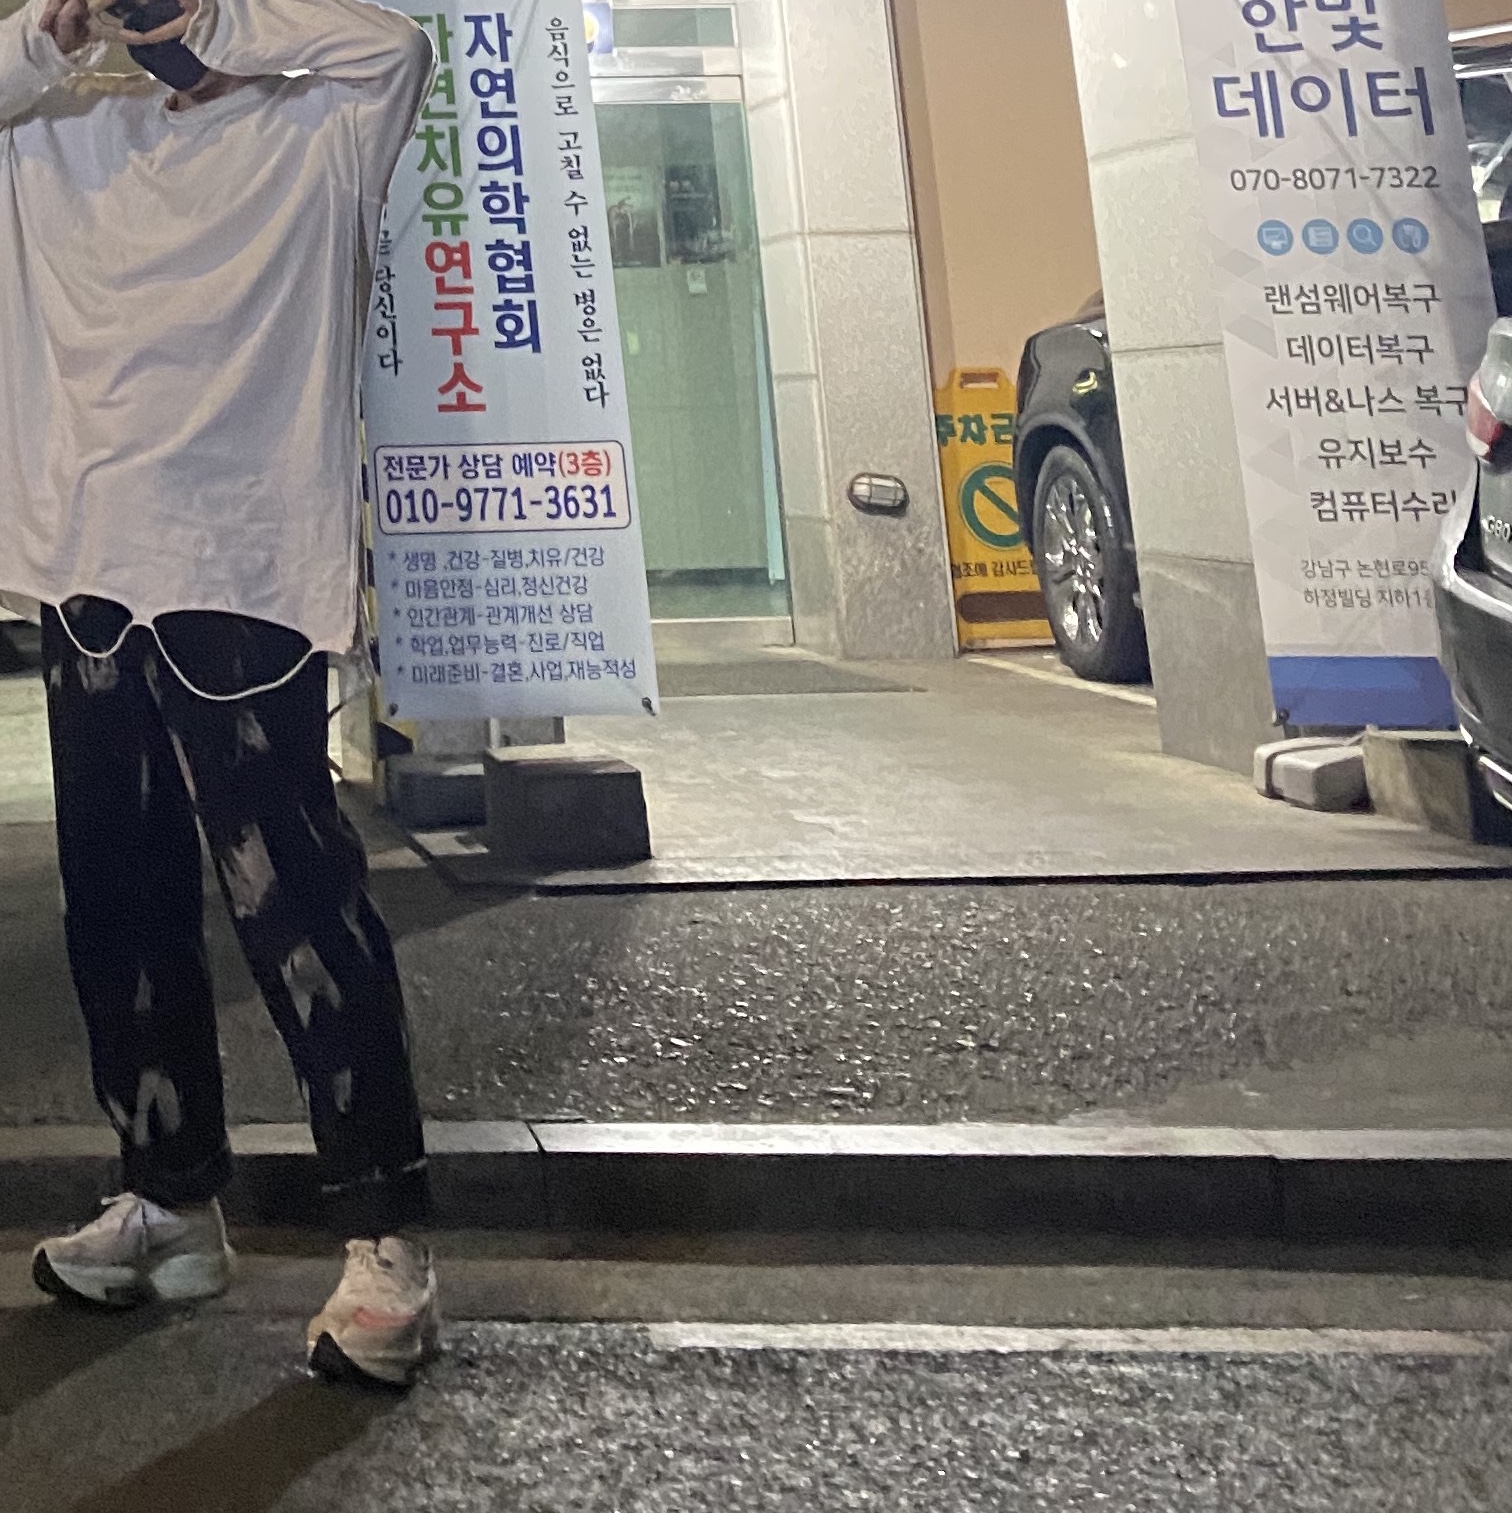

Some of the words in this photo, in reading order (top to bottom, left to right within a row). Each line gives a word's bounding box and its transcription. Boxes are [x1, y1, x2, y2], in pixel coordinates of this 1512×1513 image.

[544, 17, 579, 117] 음식으로
[1212, 66, 1435, 139] 데이터
[558, 131, 585, 181] 고칠
[463, 13, 542, 355] 자연의학협회
[1230, 165, 1440, 192] 070-8071-7322
[564, 189, 589, 217] 수
[567, 225, 596, 280] 없는
[573, 289, 603, 344] 병은
[1264, 283, 1442, 316] 랜섬웨어복구
[374, 265, 404, 378] 당신이다
[1286, 334, 1435, 367] 데이터복구
[582, 353, 611, 409] 없다
[1266, 386, 1406, 418] 서버&나스
[1414, 385, 1469, 417] 복구
[936, 412, 1015, 448] 주차금
[383, 454, 450, 482] 전문가
[458, 452, 504, 480] 상담
[512, 449, 612, 479] 예약(3층)
[1317, 437, 1438, 471] 유지보수
[386, 483, 617, 525] 010-9771-3631
[1310, 488, 1456, 524] 컴퓨터수리
[1301, 558, 1352, 580] 강남구
[560, 602, 594, 625] 상담
[1303, 587, 1373, 609] 하정빌딩
